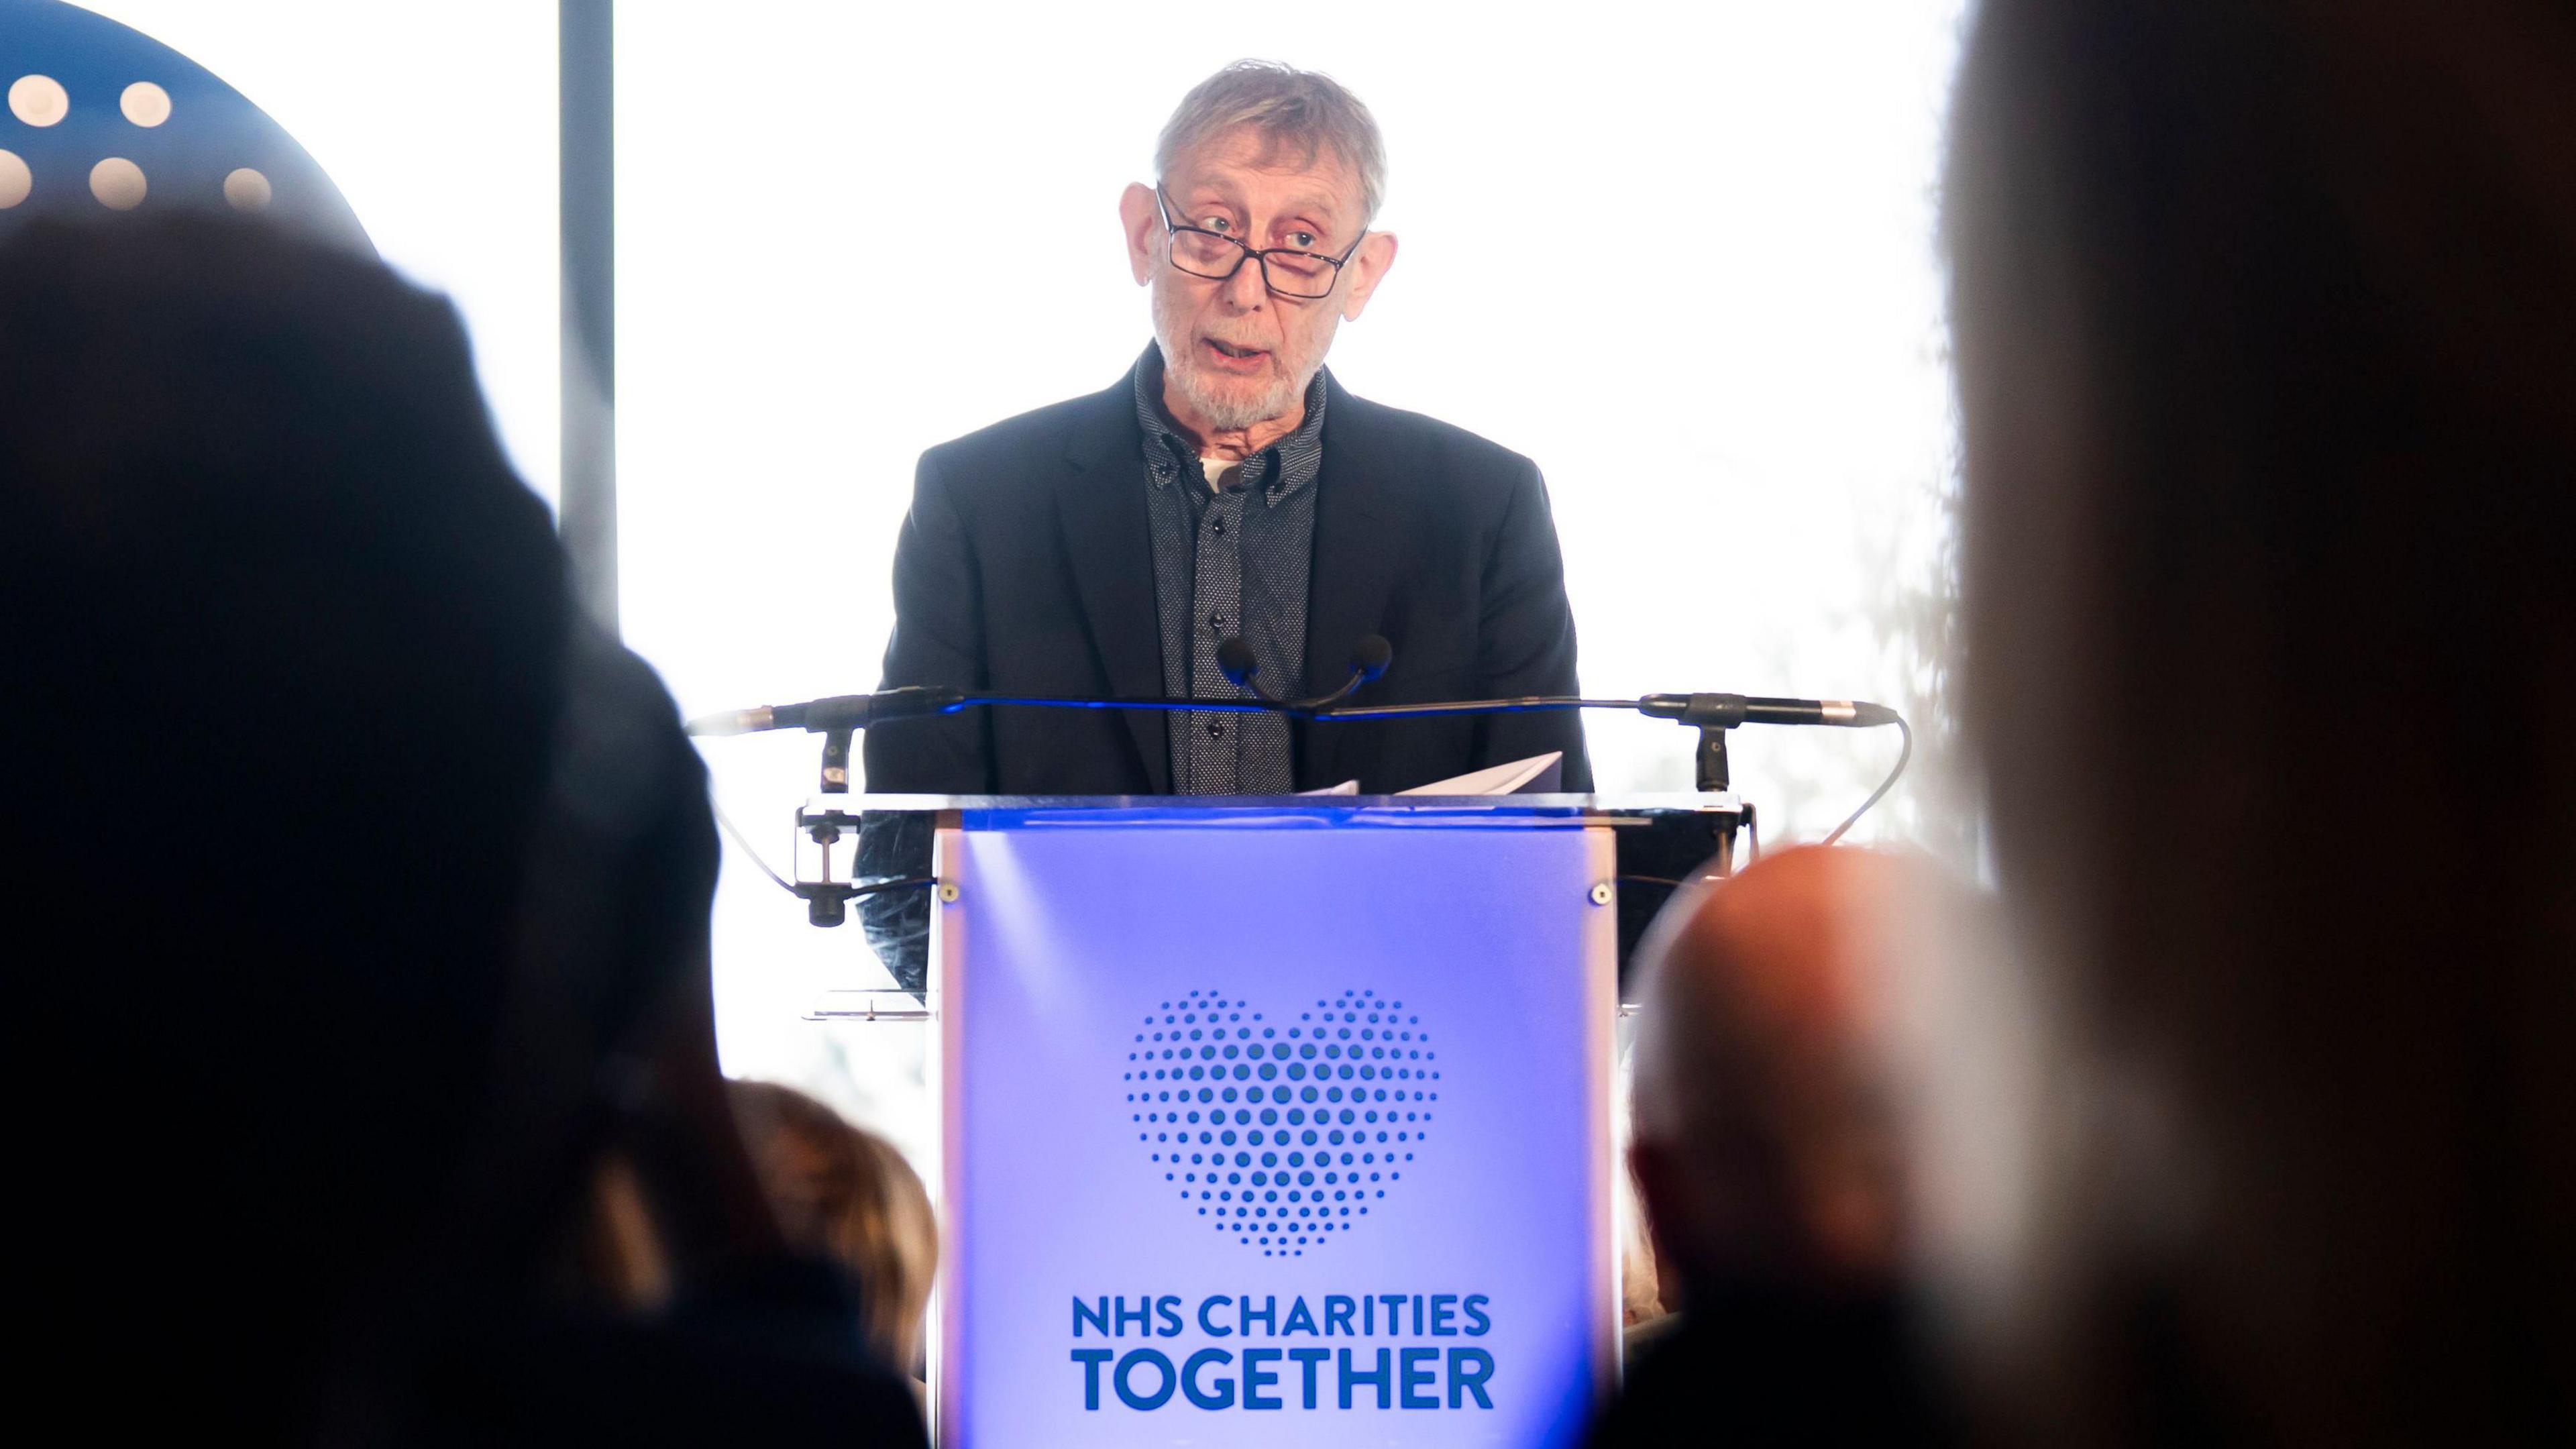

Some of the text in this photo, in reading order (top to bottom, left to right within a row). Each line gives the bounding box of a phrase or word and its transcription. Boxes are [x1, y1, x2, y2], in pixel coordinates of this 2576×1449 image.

[1073, 1295, 1491, 1337] NHS CHARITIES
[1071, 1348, 1495, 1411] TOGETHER
